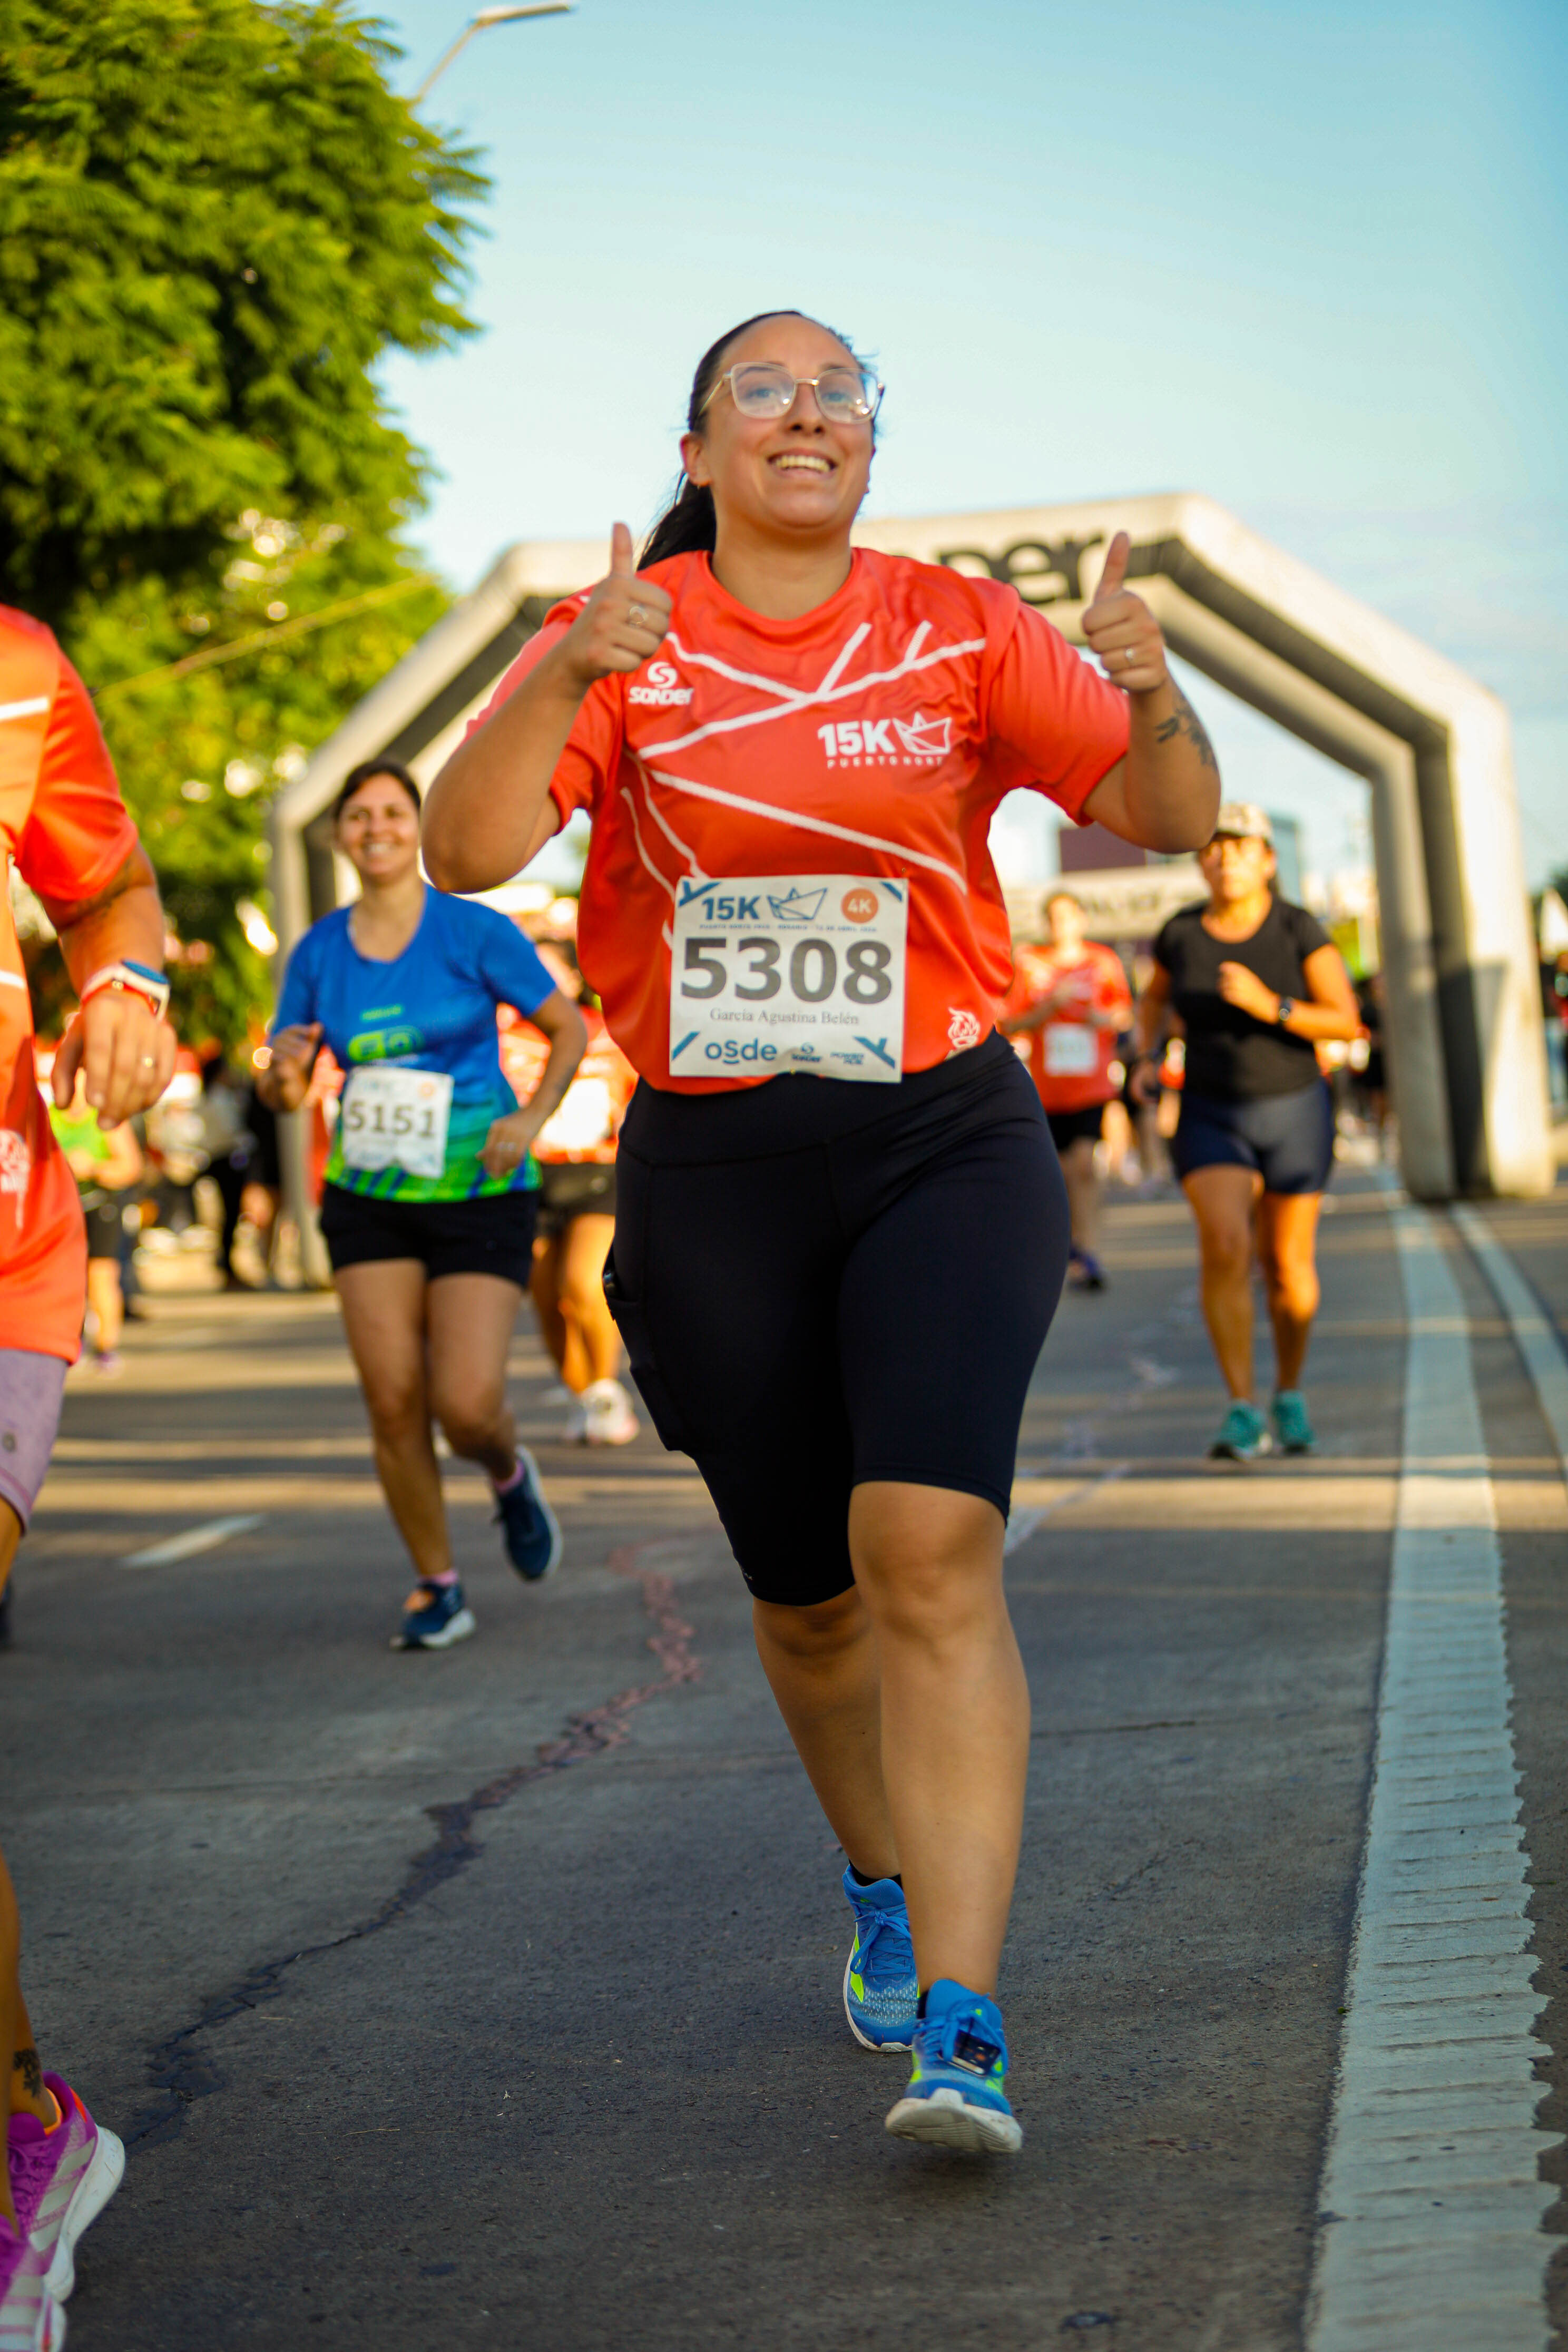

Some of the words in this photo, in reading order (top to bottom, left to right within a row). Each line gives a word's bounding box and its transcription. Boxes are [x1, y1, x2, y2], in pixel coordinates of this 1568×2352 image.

[818, 719, 895, 757] 15K
[827, 756, 898, 769] PUERTO
[903, 756, 943, 767] NORT
[701, 896, 760, 920] 15K
[847, 898, 872, 914] 4K
[681, 936, 892, 1004] 5308
[710, 1006, 753, 1022] García
[758, 1010, 816, 1025] Agustina
[821, 1011, 859, 1025] Belén
[705, 1038, 777, 1061] osde
[346, 1099, 436, 1139] 5151
